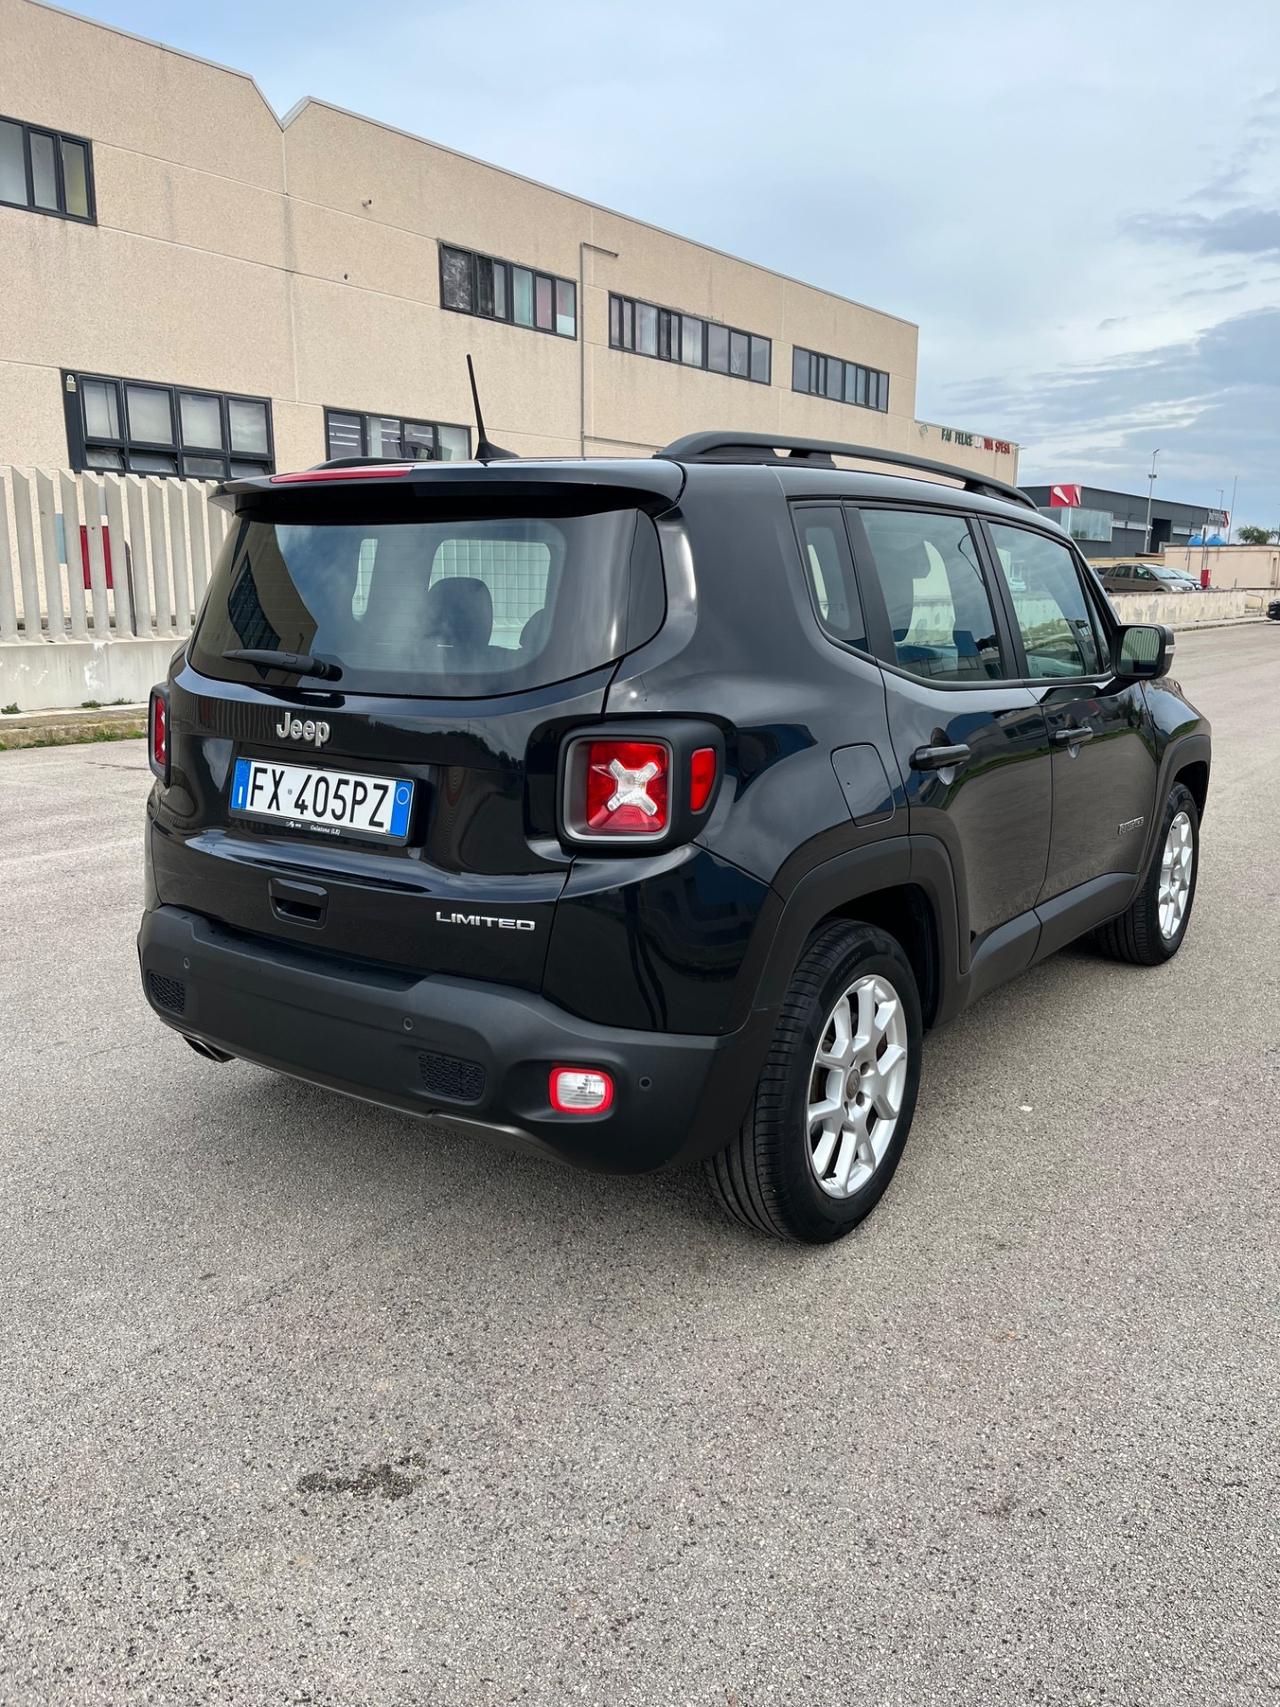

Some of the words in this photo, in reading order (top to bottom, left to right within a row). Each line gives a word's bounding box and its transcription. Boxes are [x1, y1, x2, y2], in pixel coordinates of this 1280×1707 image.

[276, 712, 330, 747] Jeep
[250, 766, 285, 811] FX
[294, 774, 390, 828] 405PZ
[436, 911, 535, 931] LIMITED
